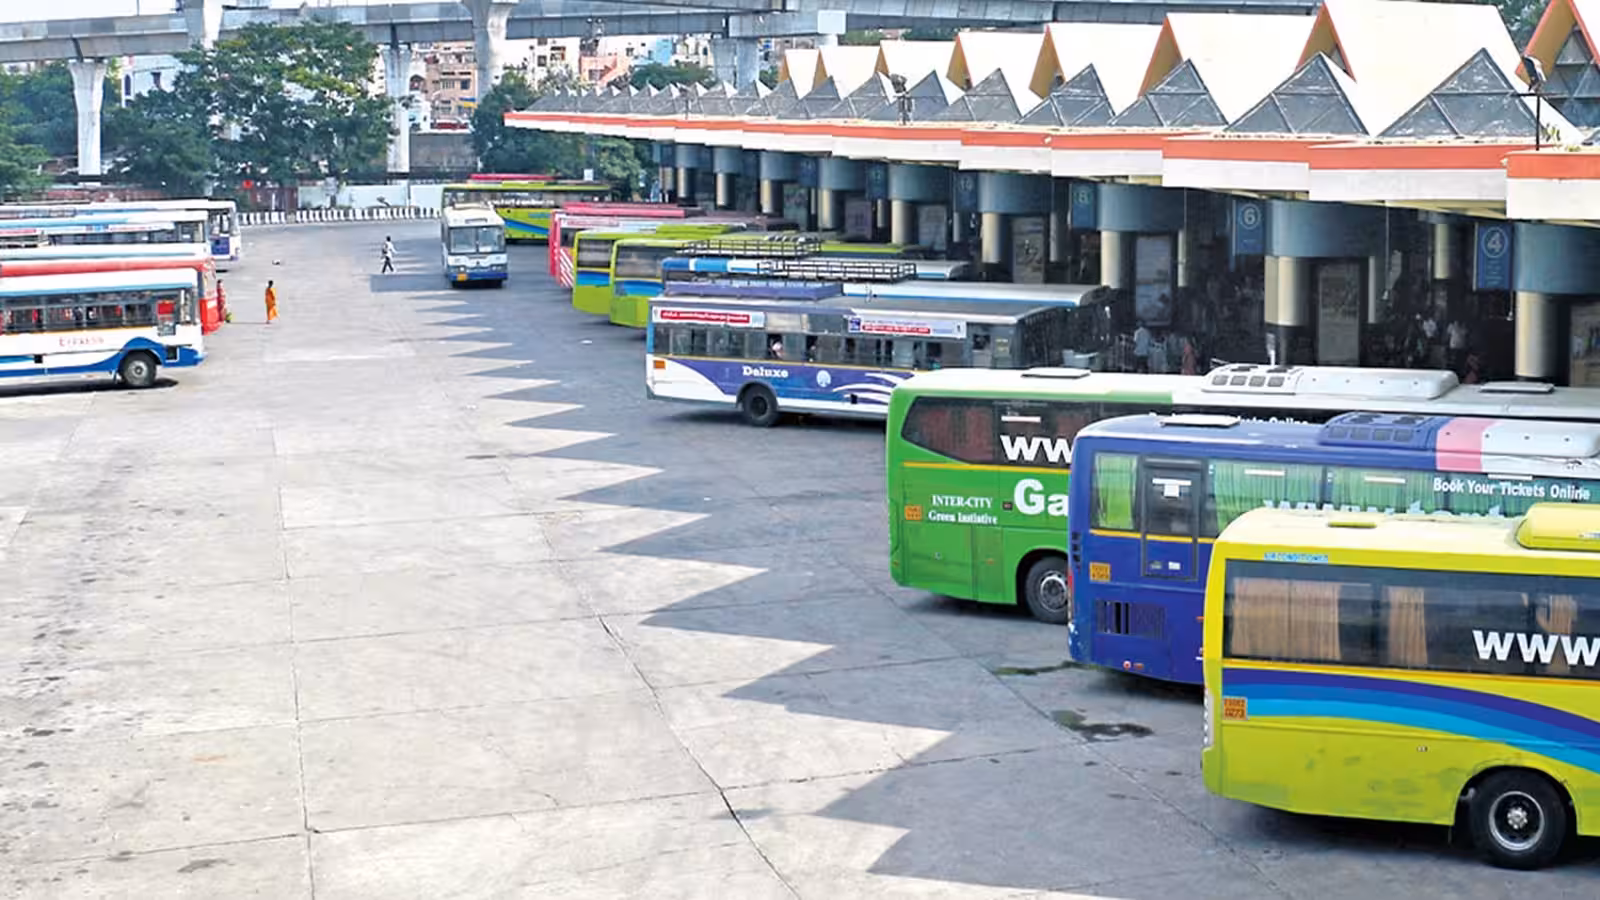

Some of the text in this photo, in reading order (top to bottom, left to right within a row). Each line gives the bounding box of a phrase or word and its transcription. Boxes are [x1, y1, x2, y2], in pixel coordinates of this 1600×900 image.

[1244, 207, 1256, 225] 6
[1487, 231, 1503, 252] 4
[742, 365, 789, 378] Deluxe
[1014, 478, 1069, 516] Ga
[1433, 477, 1591, 500] Book Your Tickets Online
[932, 494, 993, 509] INTER-CITY
[928, 510, 956, 522] Green
[958, 512, 998, 525] Initiative
